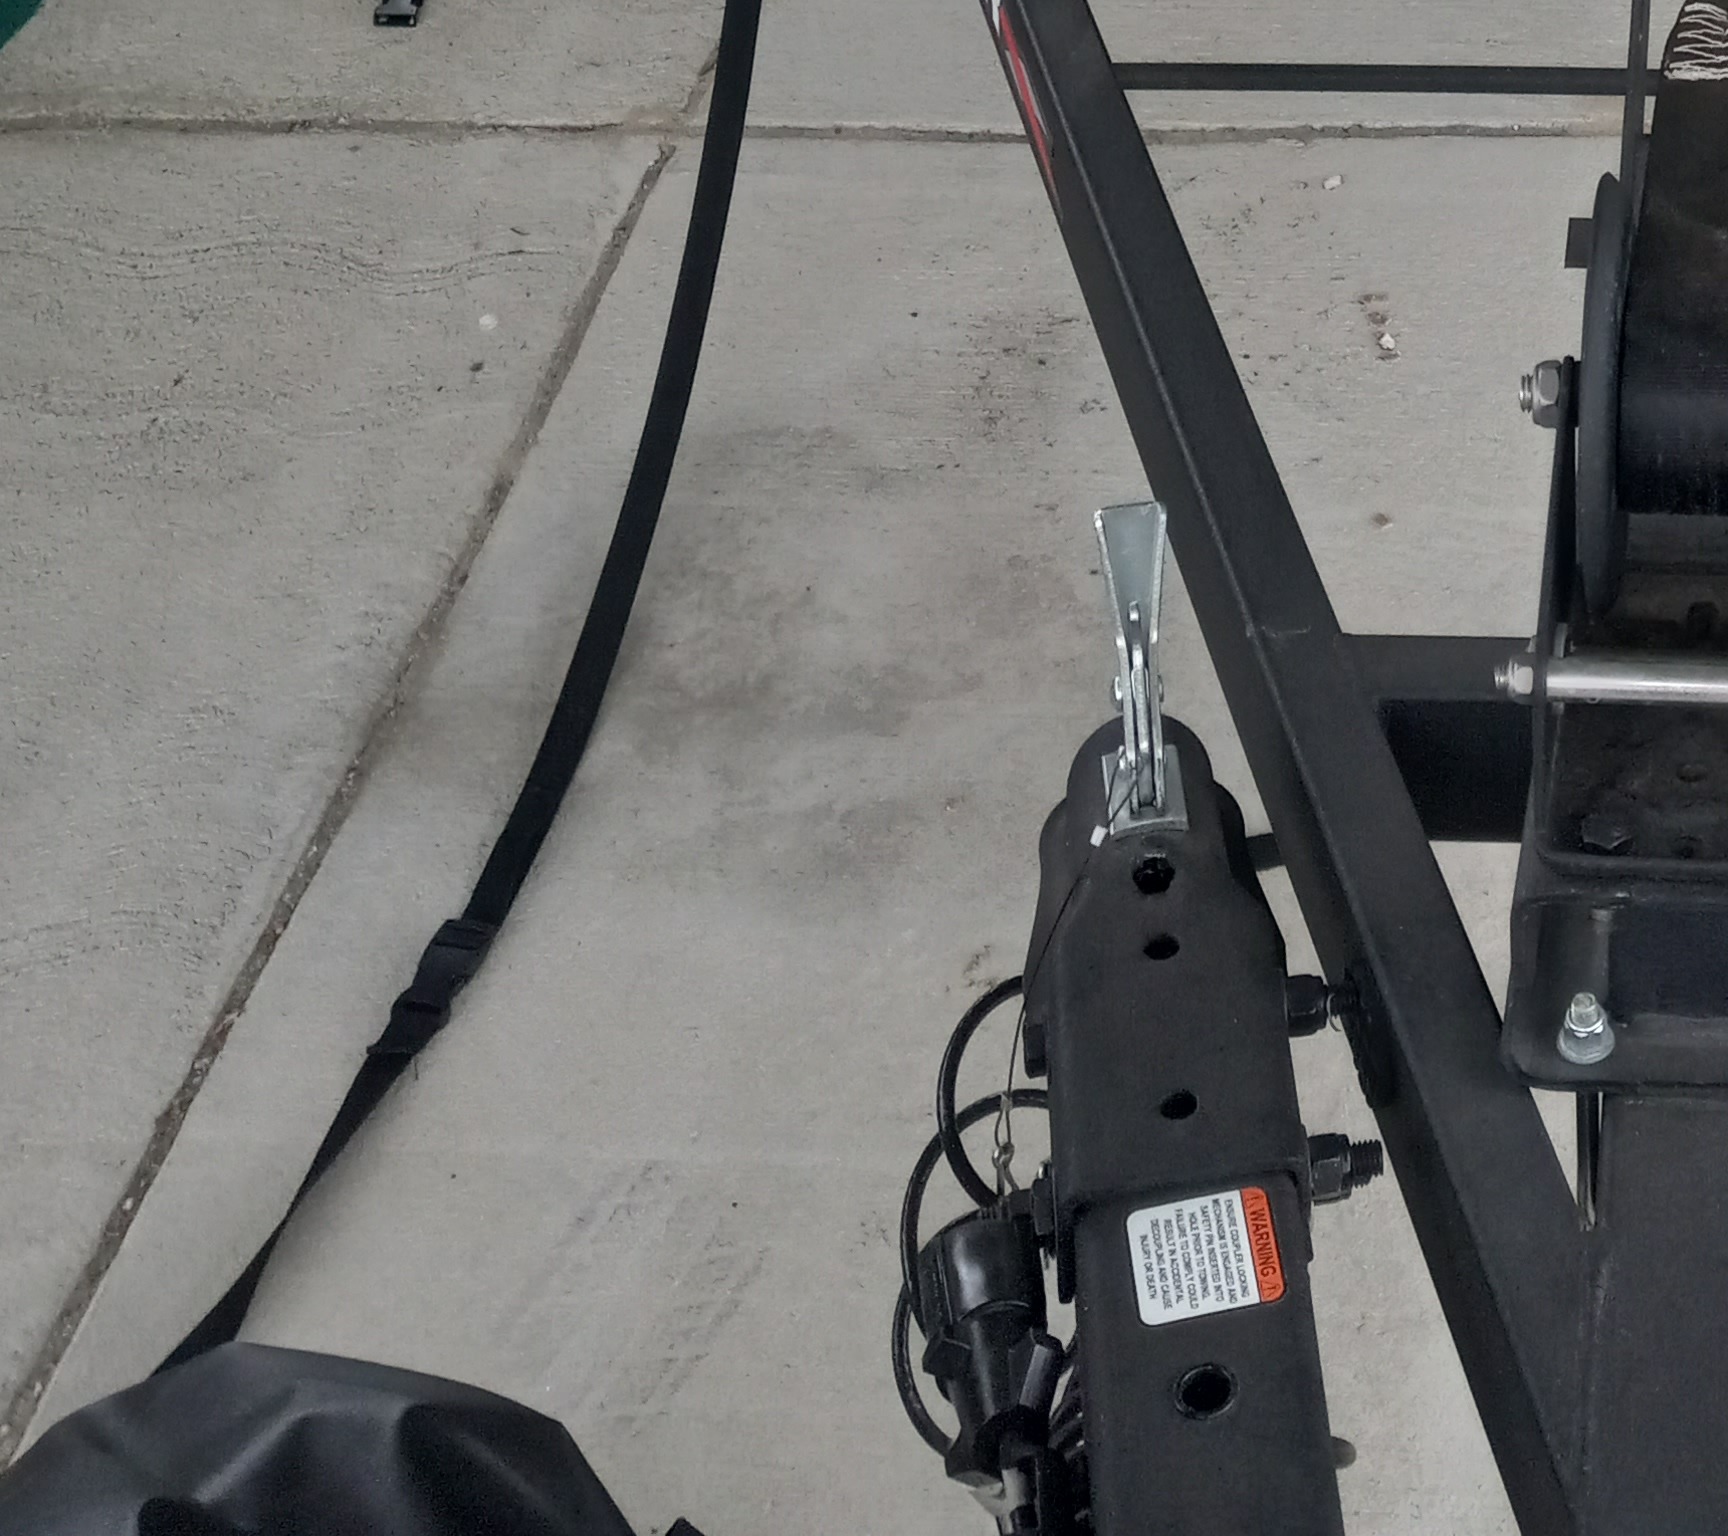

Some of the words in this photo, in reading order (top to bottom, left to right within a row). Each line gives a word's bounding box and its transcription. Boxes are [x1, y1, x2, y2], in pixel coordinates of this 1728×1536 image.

[1175, 1208, 1186, 1239] FAILURE
[1188, 1212, 1198, 1232] HOLE
[1200, 1204, 1211, 1233] SAFETY
[1212, 1198, 1225, 1241] MECHANISM
[1225, 1198, 1236, 1227] ENSURE
[1150, 1219, 1164, 1266] DECOUPLING
[1163, 1218, 1174, 1247] RESULT
[1180, 1239, 1187, 1250] TO
[1192, 1232, 1201, 1255] PRIOR
[1205, 1233, 1213, 1246] PIN
[1219, 1241, 1227, 1249] IS
[1230, 1228, 1242, 1263] COUPLER
[1250, 1207, 1277, 1278] WARNING
[1140, 1234, 1150, 1260] INJURY
[1168, 1248, 1175, 1256] IN
[1144, 1261, 1152, 1272] OR
[1182, 1251, 1193, 1282] COMPLY
[1196, 1256, 1203, 1267] TO
[1207, 1247, 1219, 1283] INSERTED
[1221, 1250, 1233, 1286] ENGAGED
[1146, 1274, 1156, 1299] DEATH
[1158, 1267, 1167, 1283] AND
[1170, 1257, 1183, 1303] ACCIDENTAL
[1237, 1264, 1248, 1298] LOCKING
[1161, 1284, 1171, 1309] CAUSE
[1187, 1283, 1198, 1309] COULD
[1214, 1284, 1223, 1302] INTO
[1228, 1287, 1236, 1304] AND
